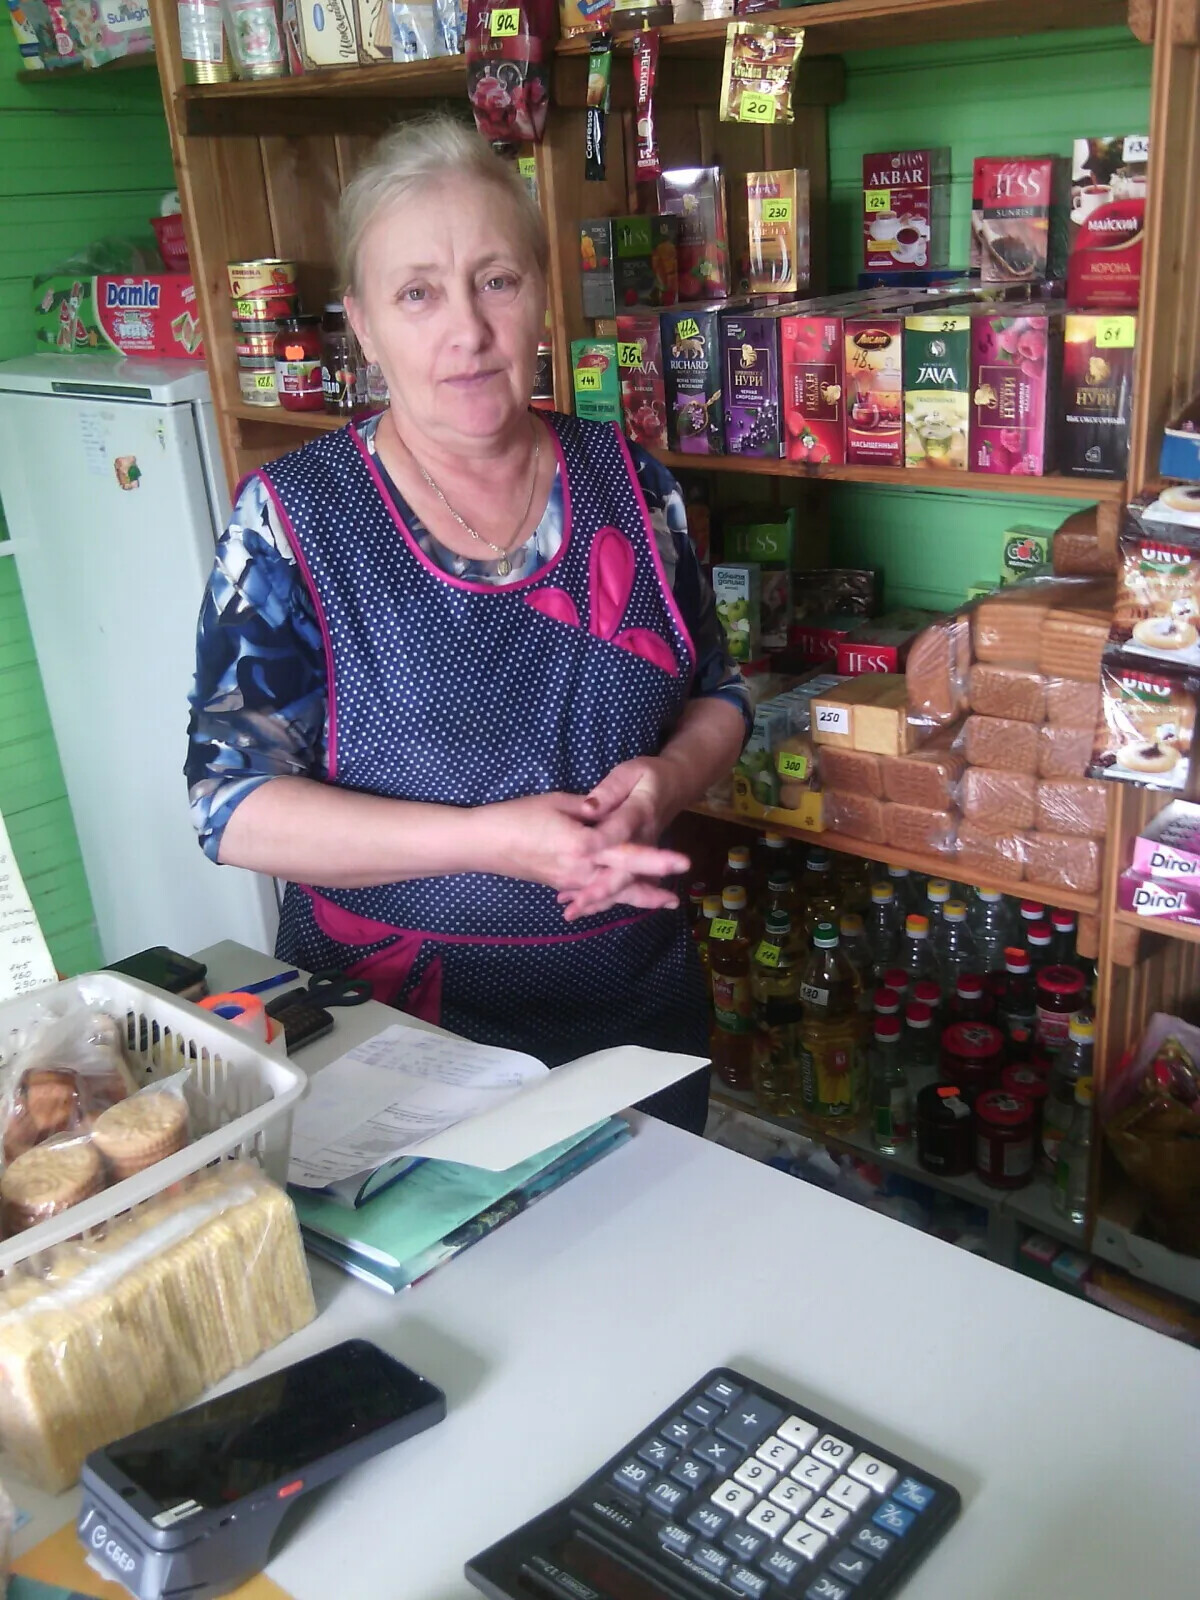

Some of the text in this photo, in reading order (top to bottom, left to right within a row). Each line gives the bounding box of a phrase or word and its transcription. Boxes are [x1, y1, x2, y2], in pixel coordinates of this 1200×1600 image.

[107, 7, 150, 25] Sunligh
[747, 101, 768, 114] 20
[869, 169, 923, 186] AKBAR
[994, 169, 1042, 199] TESS
[870, 198, 885, 208] 124
[768, 207, 788, 218] 230
[996, 208, 1034, 217] SUNRISE
[1088, 216, 1138, 231] МАЙСКИЙ
[1090, 263, 1131, 273] КОРОНА
[107, 281, 160, 307] Damla
[671, 360, 709, 370] RICHARD
[735, 375, 763, 387] НУРИ
[915, 367, 959, 384] JAVA
[805, 373, 815, 411] НУРИ
[1004, 377, 1016, 419] НУРИ
[1076, 392, 1117, 406] НУРИ
[851, 441, 899, 449] НАСЫЩЕННЫЙ
[737, 531, 778, 554] TESS
[846, 651, 889, 673] TESS
[820, 711, 840, 723] 250
[784, 761, 801, 771] 300
[1150, 852, 1197, 873] Dirol
[1136, 890, 1183, 909] Dirol
[770, 1446, 784, 1457] 3
[821, 1440, 844, 1457] 00
[621, 1464, 646, 1480] OFF
[805, 1464, 820, 1477] 2
[866, 1463, 880, 1475] 0
[655, 1484, 681, 1502] MU
[783, 1487, 798, 1500] 5
[842, 1485, 853, 1496] 1
[699, 1510, 723, 1528] M+
[760, 1510, 776, 1523] 8
[820, 1507, 835, 1519] 4
[797, 1532, 813, 1545] 7
[105, 1540, 136, 1572] СБЕР
[769, 1551, 797, 1572] MR
